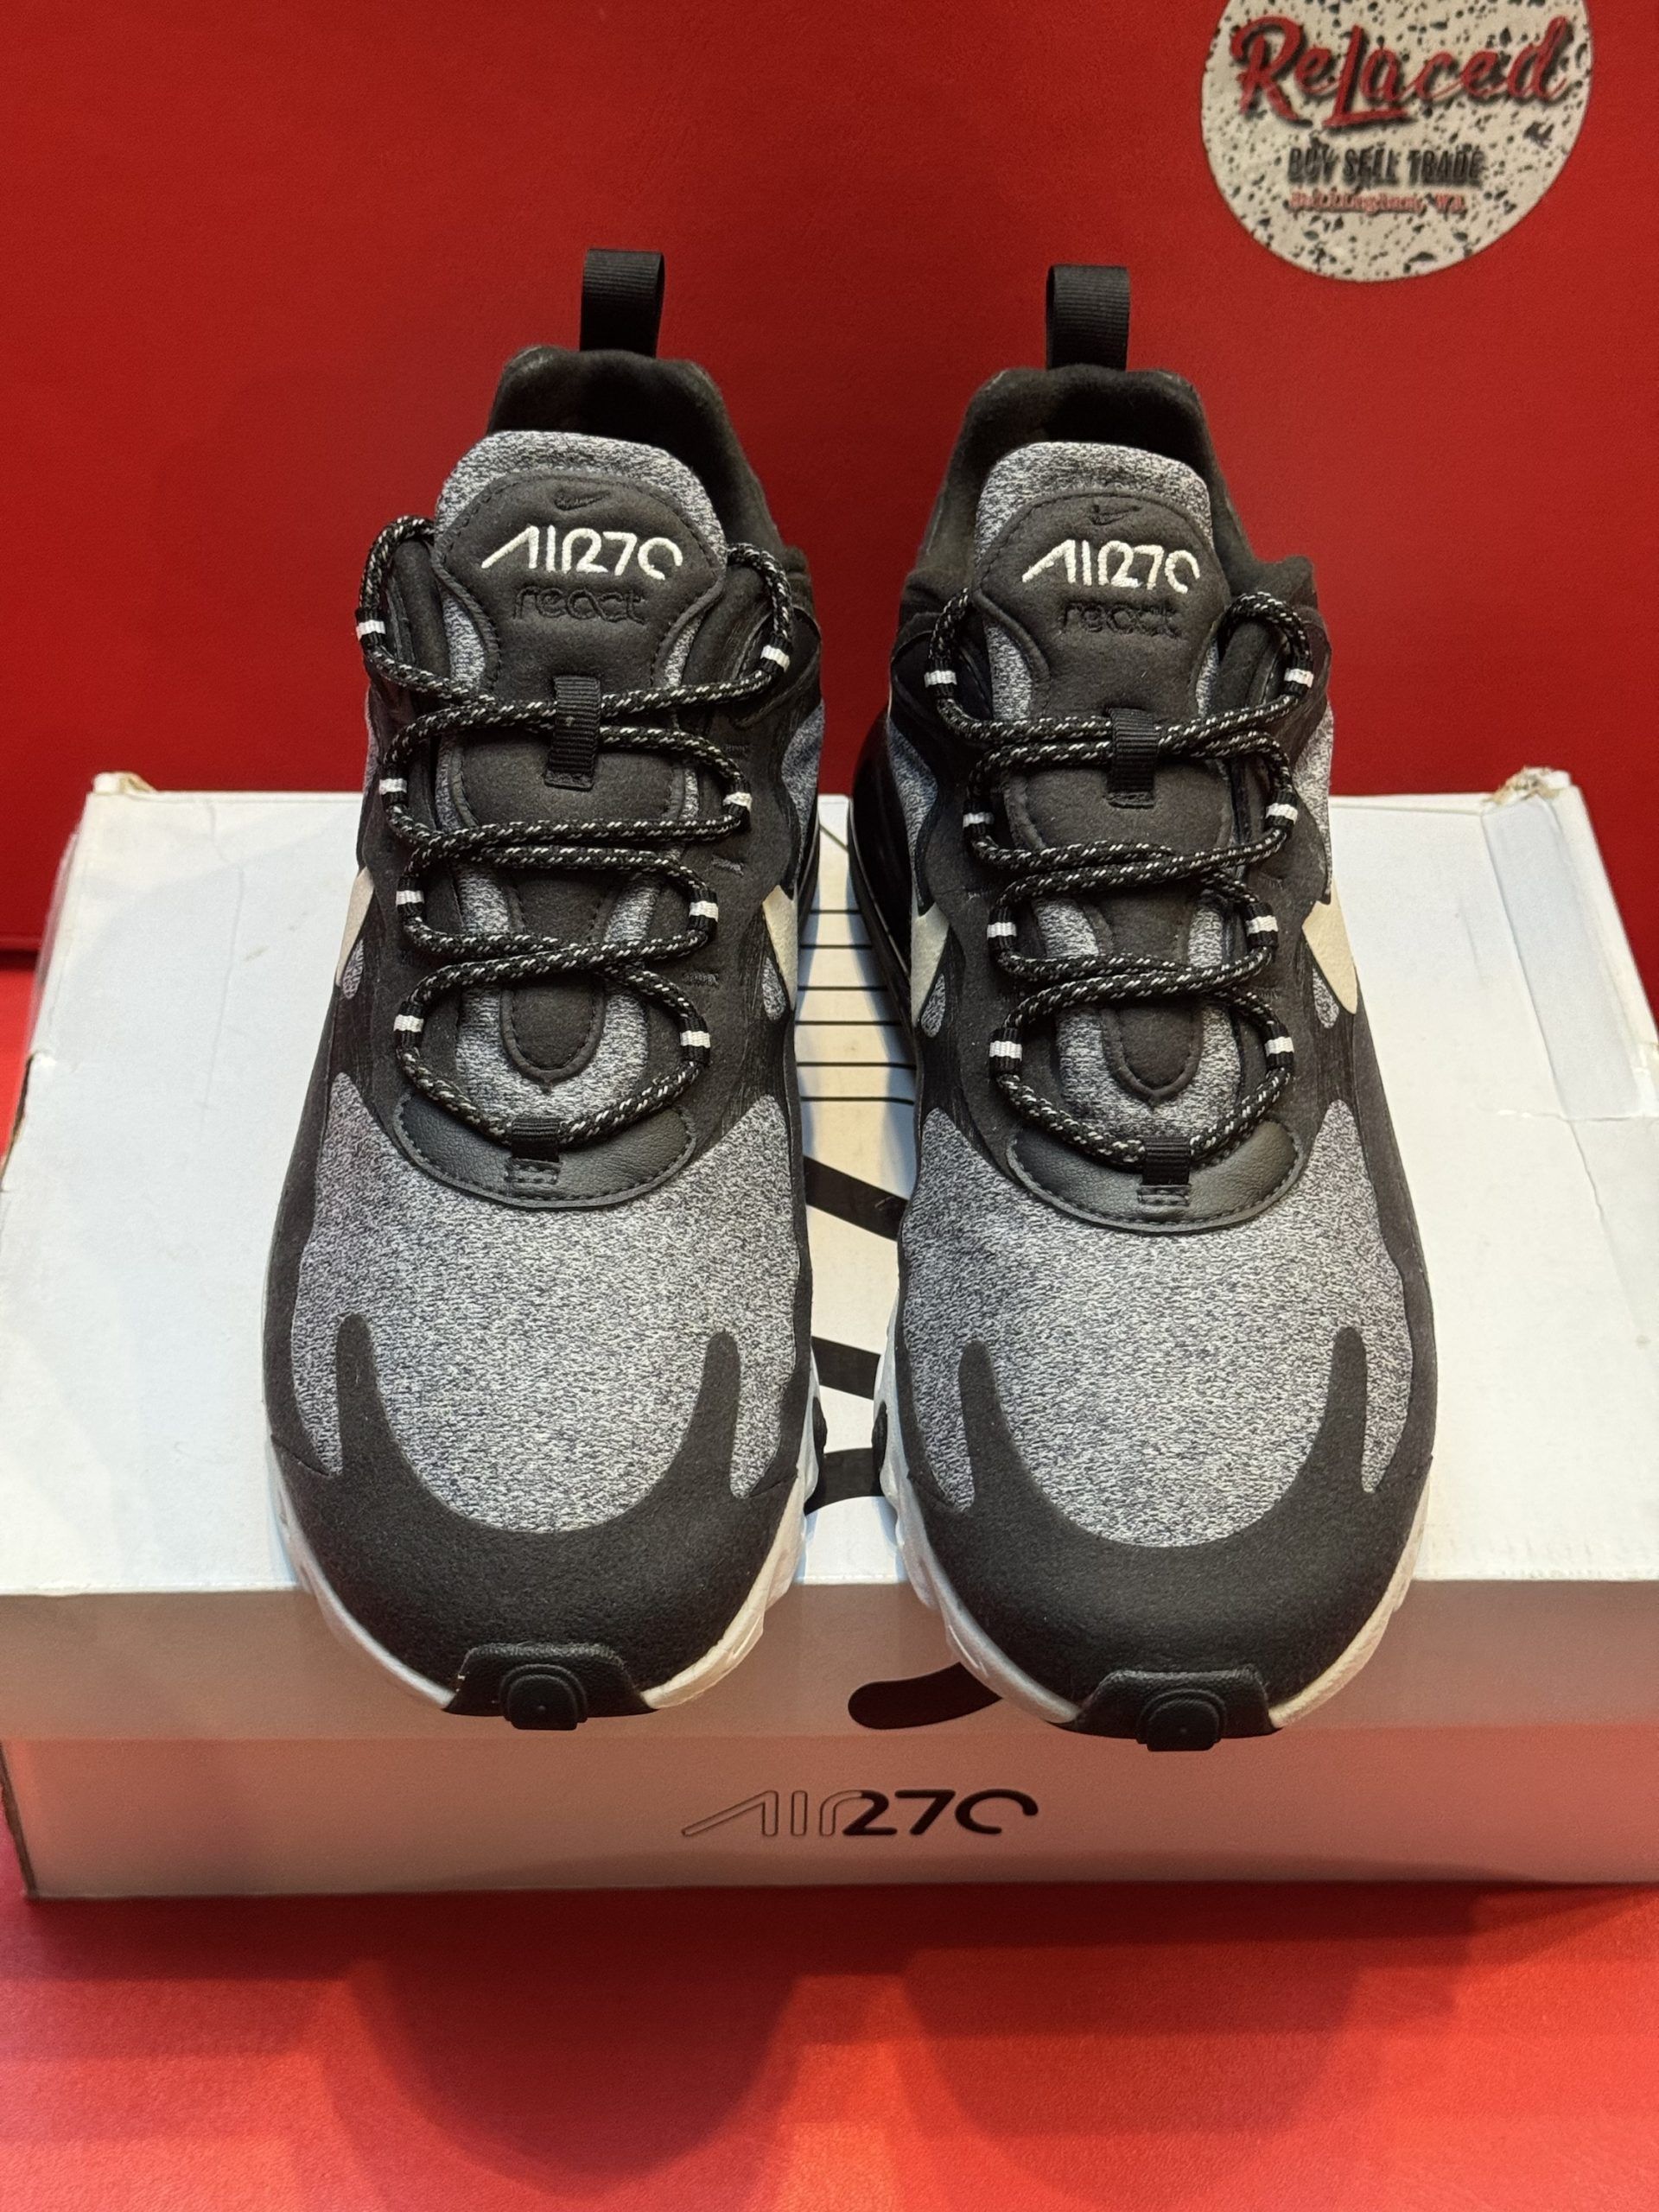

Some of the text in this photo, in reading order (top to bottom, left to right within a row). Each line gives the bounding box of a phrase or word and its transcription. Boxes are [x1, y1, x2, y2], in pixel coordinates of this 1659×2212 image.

[1287, 145, 1484, 188] BUY SELL TRADE
